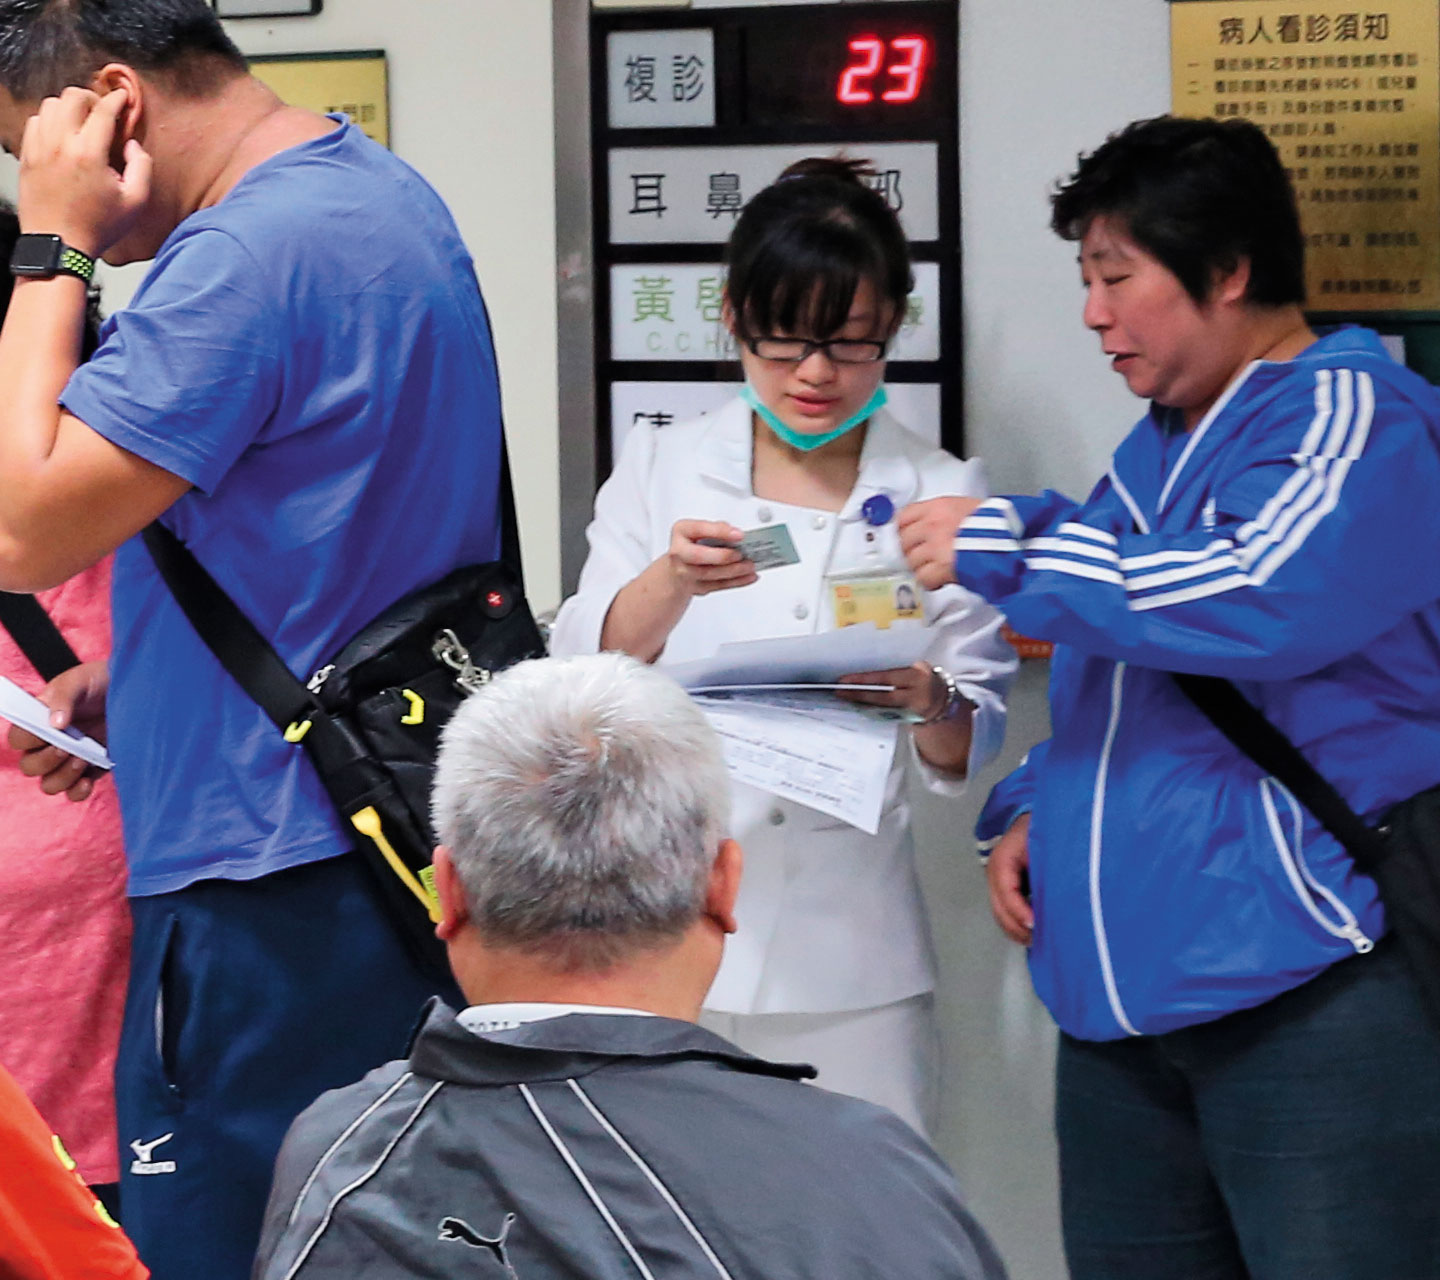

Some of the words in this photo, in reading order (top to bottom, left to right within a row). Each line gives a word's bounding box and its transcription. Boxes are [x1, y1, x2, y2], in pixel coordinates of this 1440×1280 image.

[1219, 13, 1389, 45] 病人看診須知
[624, 53, 705, 104] 複診
[838, 35, 928, 106] 23
